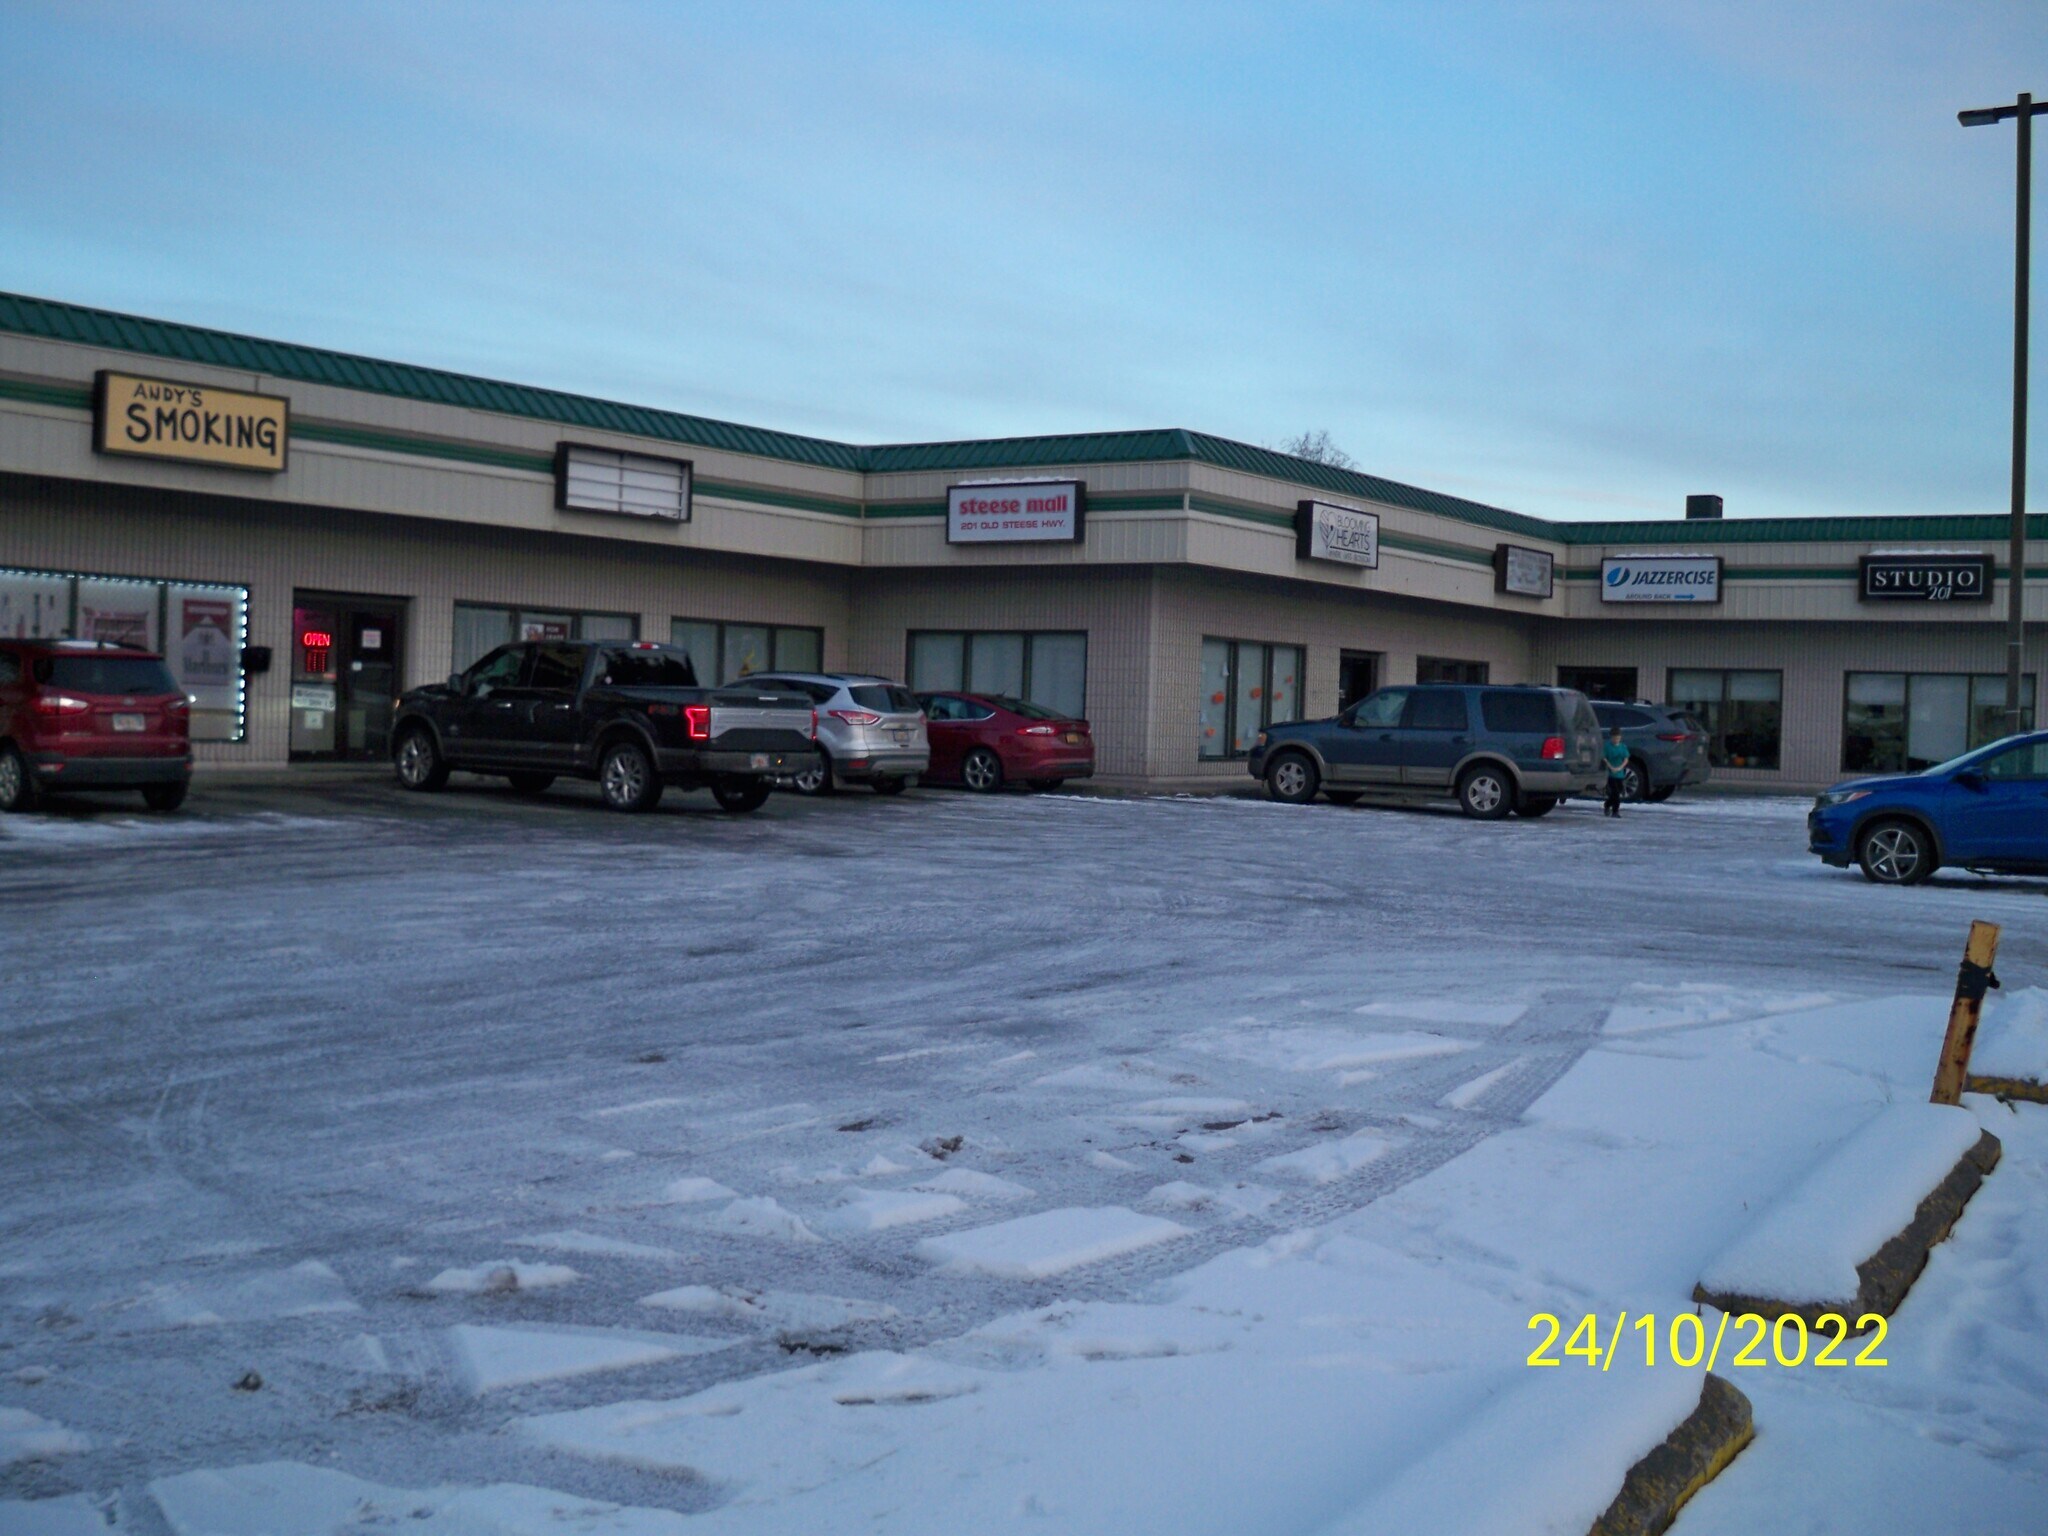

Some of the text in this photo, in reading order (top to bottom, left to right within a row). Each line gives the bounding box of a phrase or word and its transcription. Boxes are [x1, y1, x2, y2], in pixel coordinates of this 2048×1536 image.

[133, 383, 203, 407] ANDY'S
[125, 403, 278, 456] SMOKING
[959, 495, 1068, 515] steese mall
[960, 519, 1066, 530] 201 OLD STEESE HWY.
[1336, 529, 1370, 551] HEARTS
[1631, 570, 1715, 586] JAZZERCISE
[1875, 570, 1975, 587] STUDIO
[1928, 586, 1952, 600] 201
[304, 632, 331, 647] OPEN
